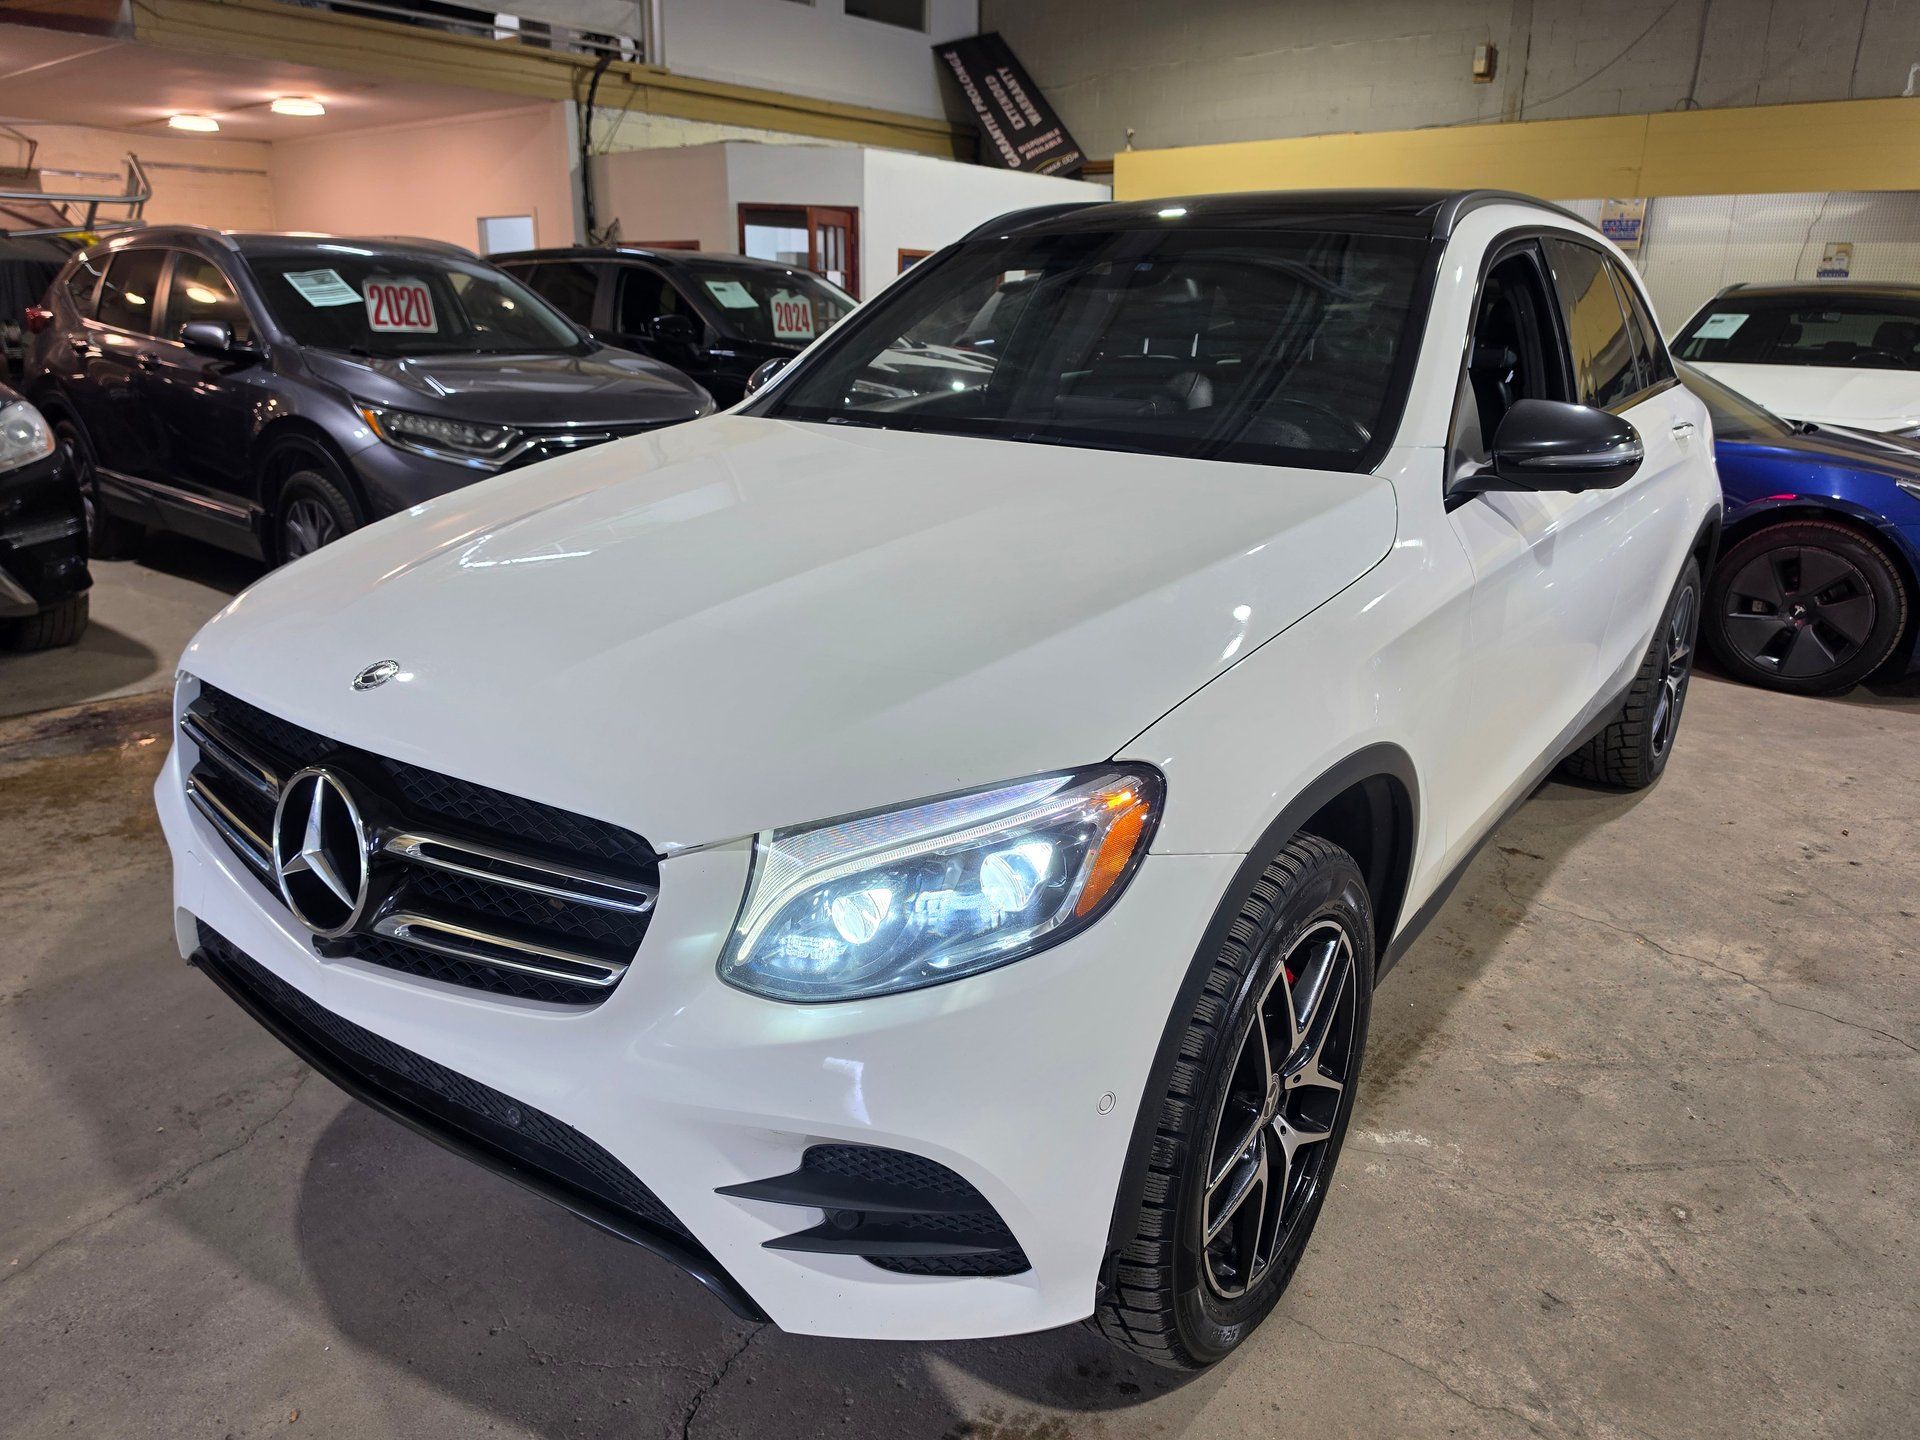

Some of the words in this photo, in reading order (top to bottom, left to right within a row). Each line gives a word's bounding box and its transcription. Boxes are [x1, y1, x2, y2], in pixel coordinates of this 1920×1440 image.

[984, 75, 1026, 131] EXTENDED
[997, 66, 1043, 127] WARRANTY
[980, 112, 1022, 168] GARANTIE
[368, 284, 432, 327] 2020
[775, 302, 810, 332] 2024
